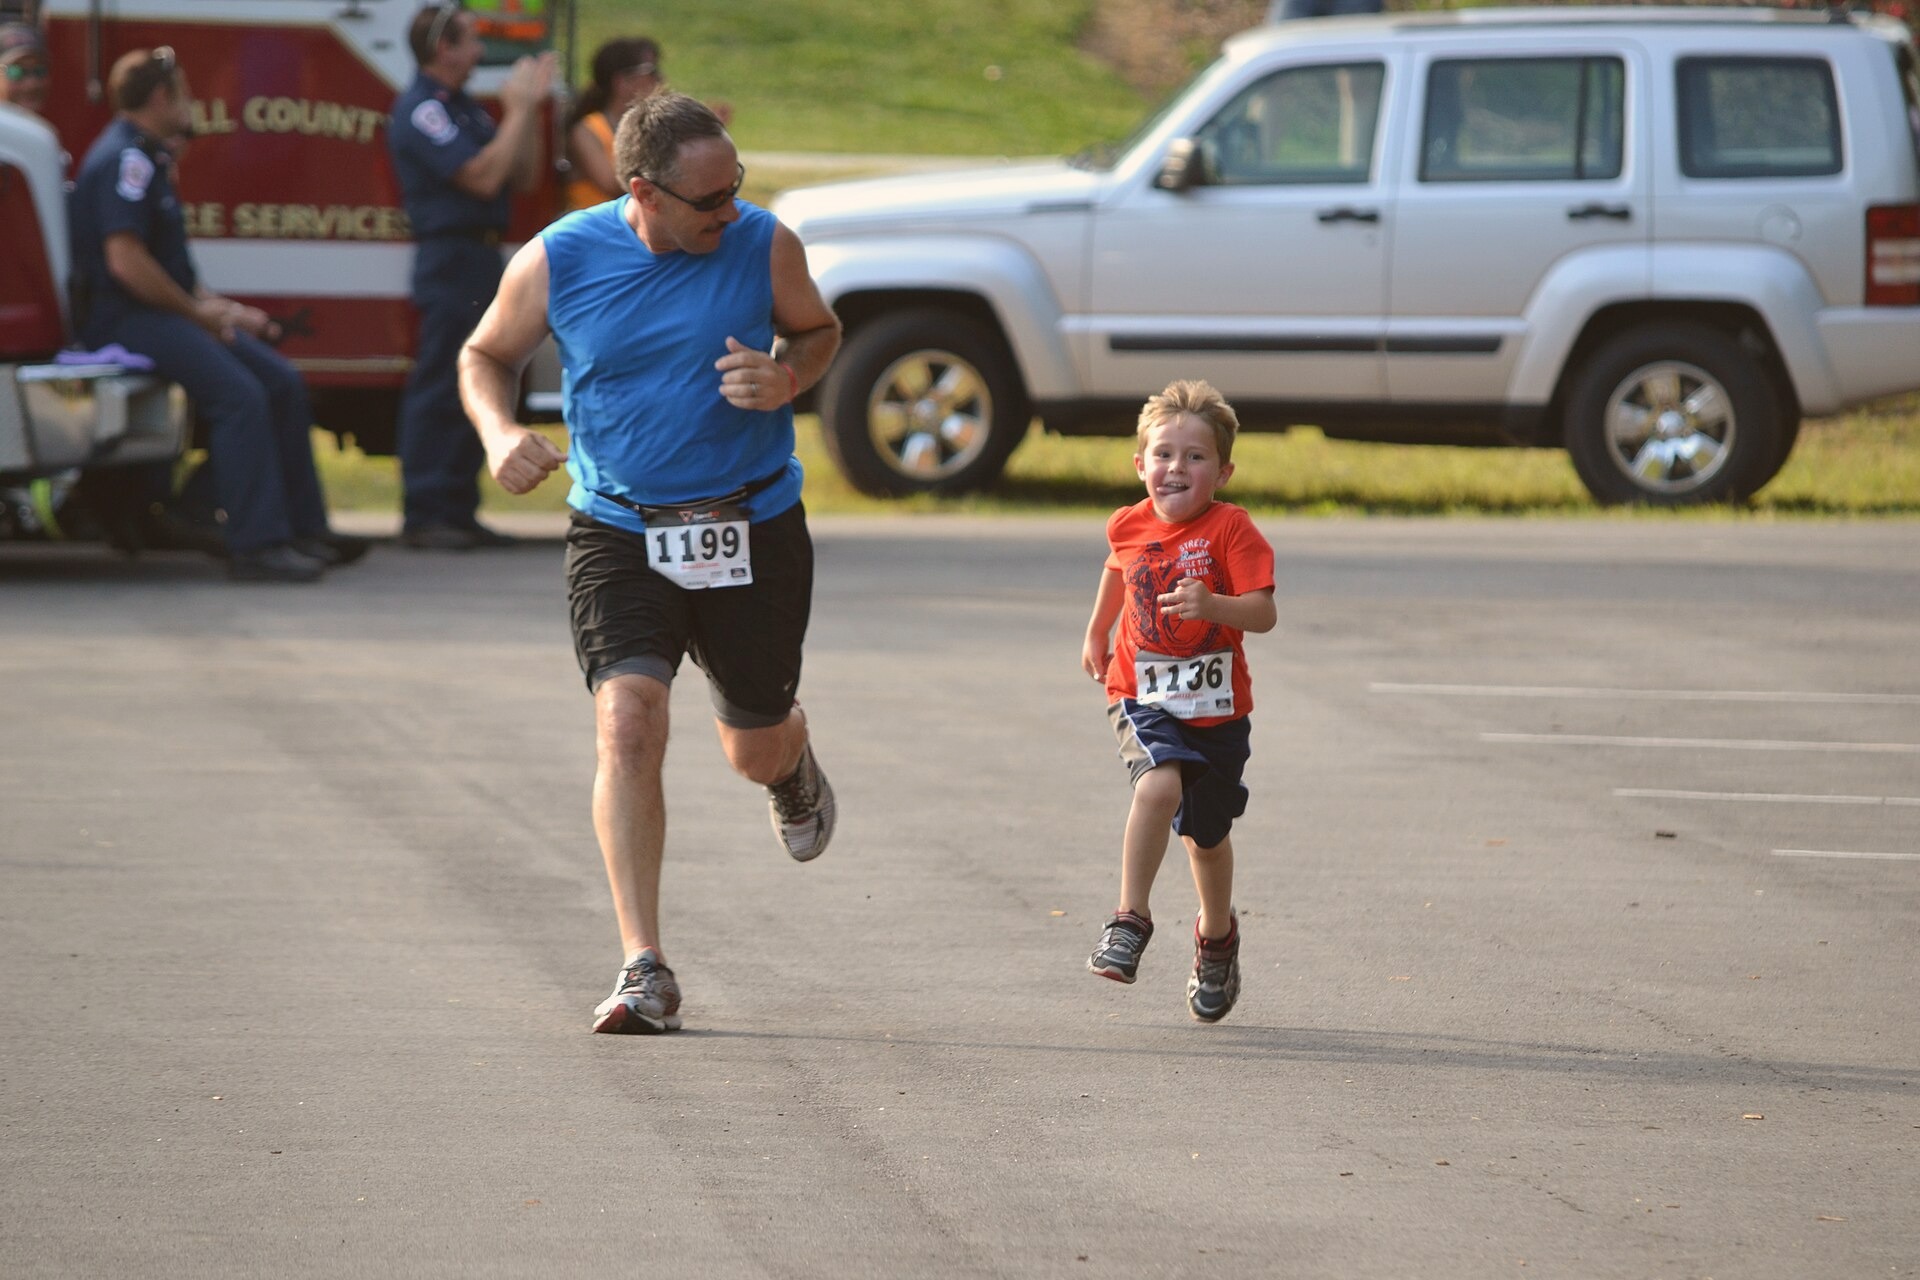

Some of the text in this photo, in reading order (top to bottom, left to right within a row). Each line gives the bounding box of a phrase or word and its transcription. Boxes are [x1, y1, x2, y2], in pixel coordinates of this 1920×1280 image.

[190, 98, 238, 134] LL
[656, 526, 740, 563] 1199
[1178, 538, 1211, 551] STREET
[1185, 567, 1210, 577] BAJA
[1144, 657, 1224, 695] 1136
